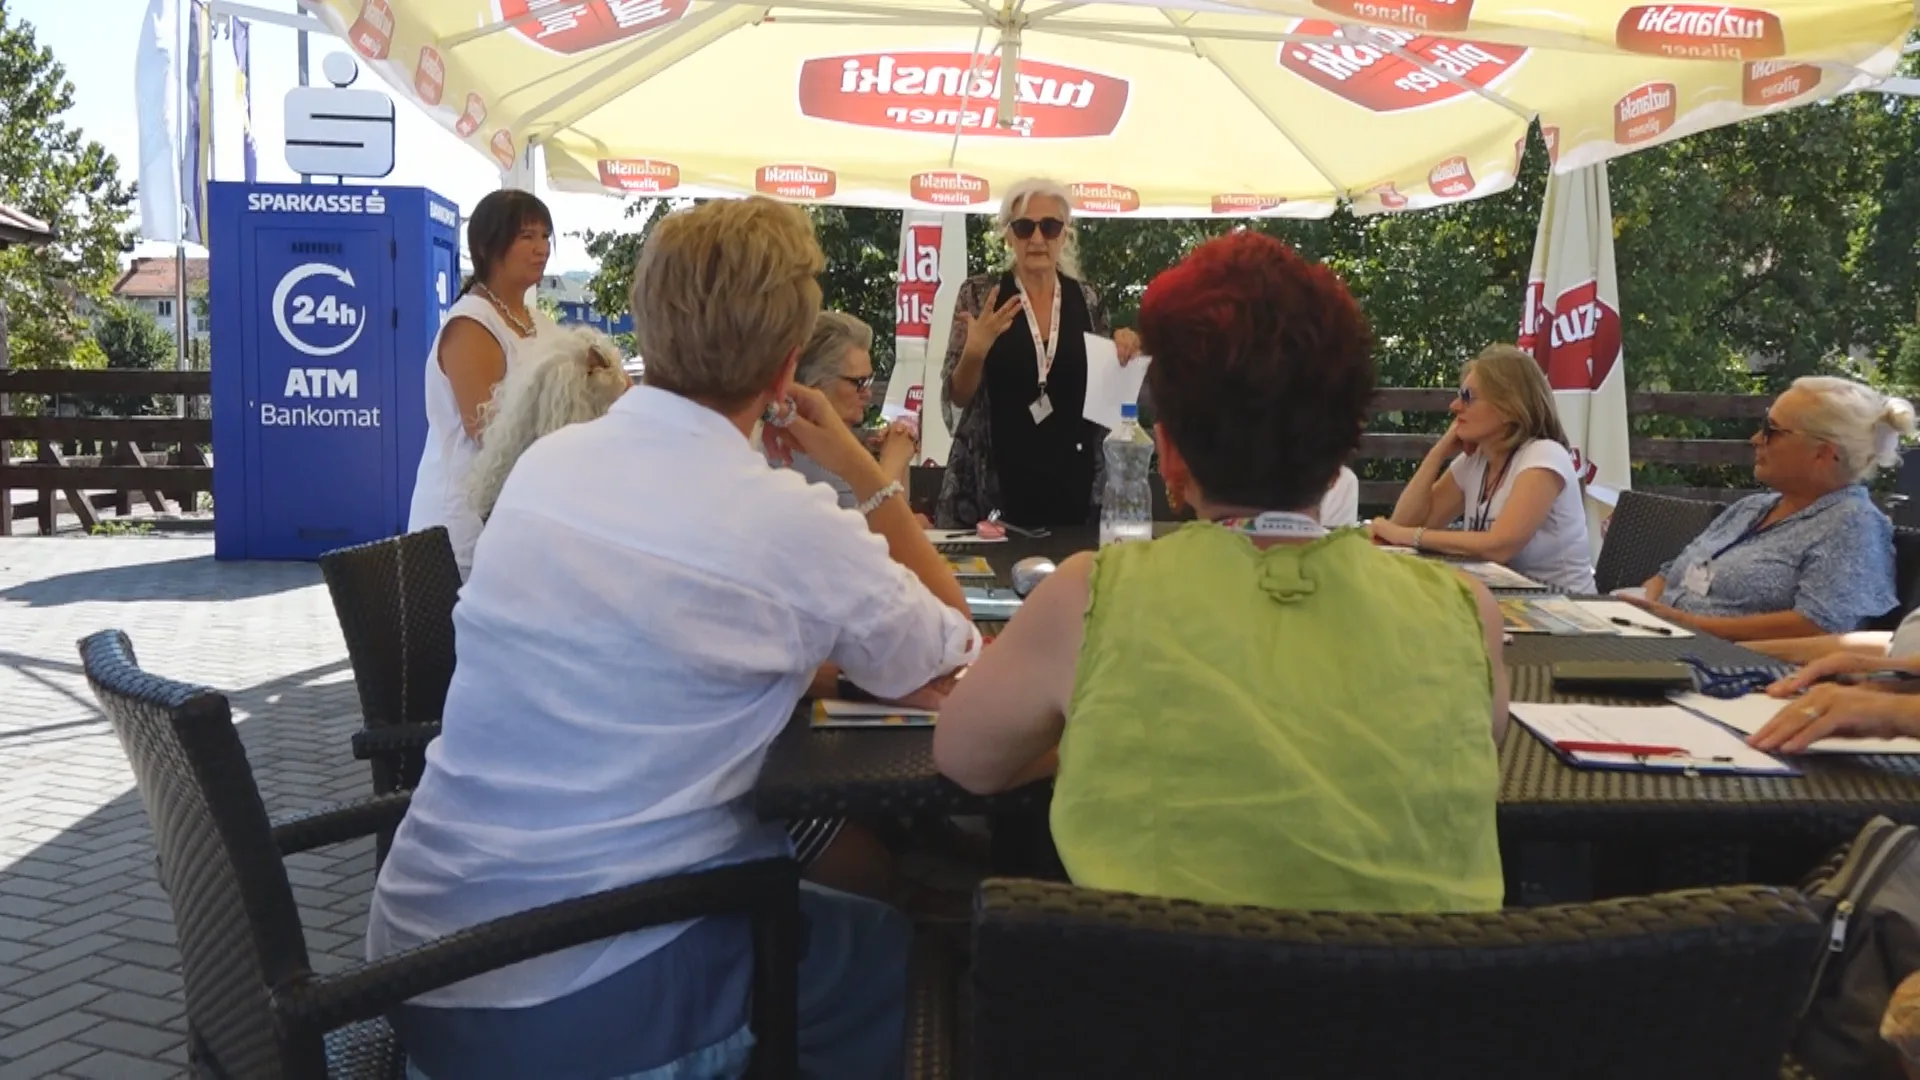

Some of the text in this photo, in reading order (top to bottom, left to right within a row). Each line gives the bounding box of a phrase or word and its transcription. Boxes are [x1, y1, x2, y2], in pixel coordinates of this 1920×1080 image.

[247, 192, 364, 213] SPARKASSE
[291, 294, 357, 326] 24h
[284, 367, 358, 398] ATM
[260, 403, 381, 427] Bankomat
